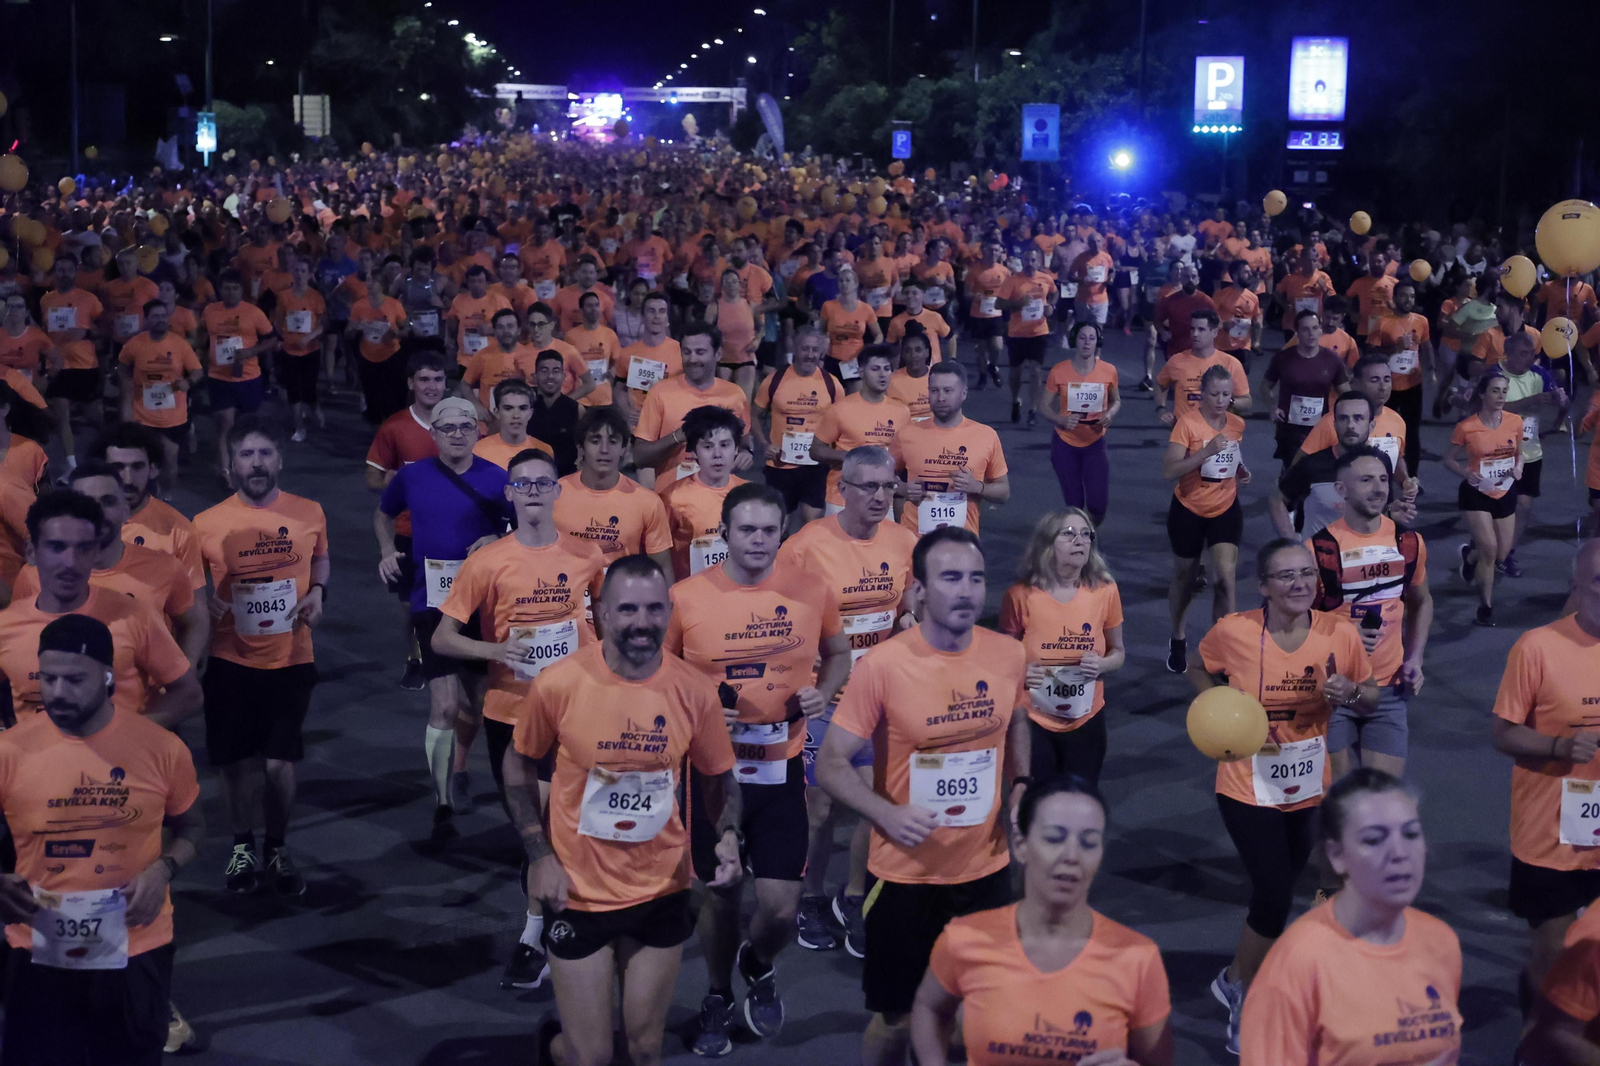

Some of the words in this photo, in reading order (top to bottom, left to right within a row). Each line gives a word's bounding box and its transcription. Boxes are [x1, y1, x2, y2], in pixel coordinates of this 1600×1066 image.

[1208, 62, 1235, 100] P
[638, 368, 654, 379] 9595
[1076, 392, 1098, 400] 17309
[1216, 454, 1234, 462] 2555
[931, 507, 956, 518] 5116
[586, 526, 620, 534] NOCTURNA
[255, 540, 294, 548] NOCTURNA
[238, 548, 272, 558] SEVILLA
[274, 546, 292, 554] KH7
[858, 576, 894, 584] NOCTURNA
[533, 587, 572, 596] NOCTURNA
[842, 585, 876, 594] SEVILLA
[876, 583, 894, 591] KH7
[515, 595, 550, 604] SEVILLA
[550, 594, 570, 604] KH7
[247, 598, 286, 614] 20843
[746, 620, 793, 630] NOCTURNA
[724, 631, 768, 640] SEVILLA
[769, 628, 792, 638] KH7
[849, 632, 879, 648] 1300
[528, 642, 568, 659] 20056
[1046, 684, 1085, 697] 14608
[948, 698, 994, 712] NOCTURNA
[926, 710, 970, 726] SEVILLA
[971, 708, 994, 719] KH7
[620, 732, 668, 742] NOCTURNA
[597, 741, 642, 752] SEVILLA
[643, 743, 666, 754] KH7
[738, 744, 766, 759] 860
[1270, 760, 1314, 779] 20128
[73, 787, 130, 796] NOCTURNA
[936, 776, 978, 796] 8693
[47, 797, 97, 808] SEVILLA
[99, 796, 128, 808] KH7
[608, 792, 652, 812] 8624
[56, 918, 102, 938] 3357
[1024, 1032, 1097, 1048] NOCTURNA
[1374, 1028, 1426, 1046] SEVILLA
[988, 1041, 1053, 1059] SEVILLA
